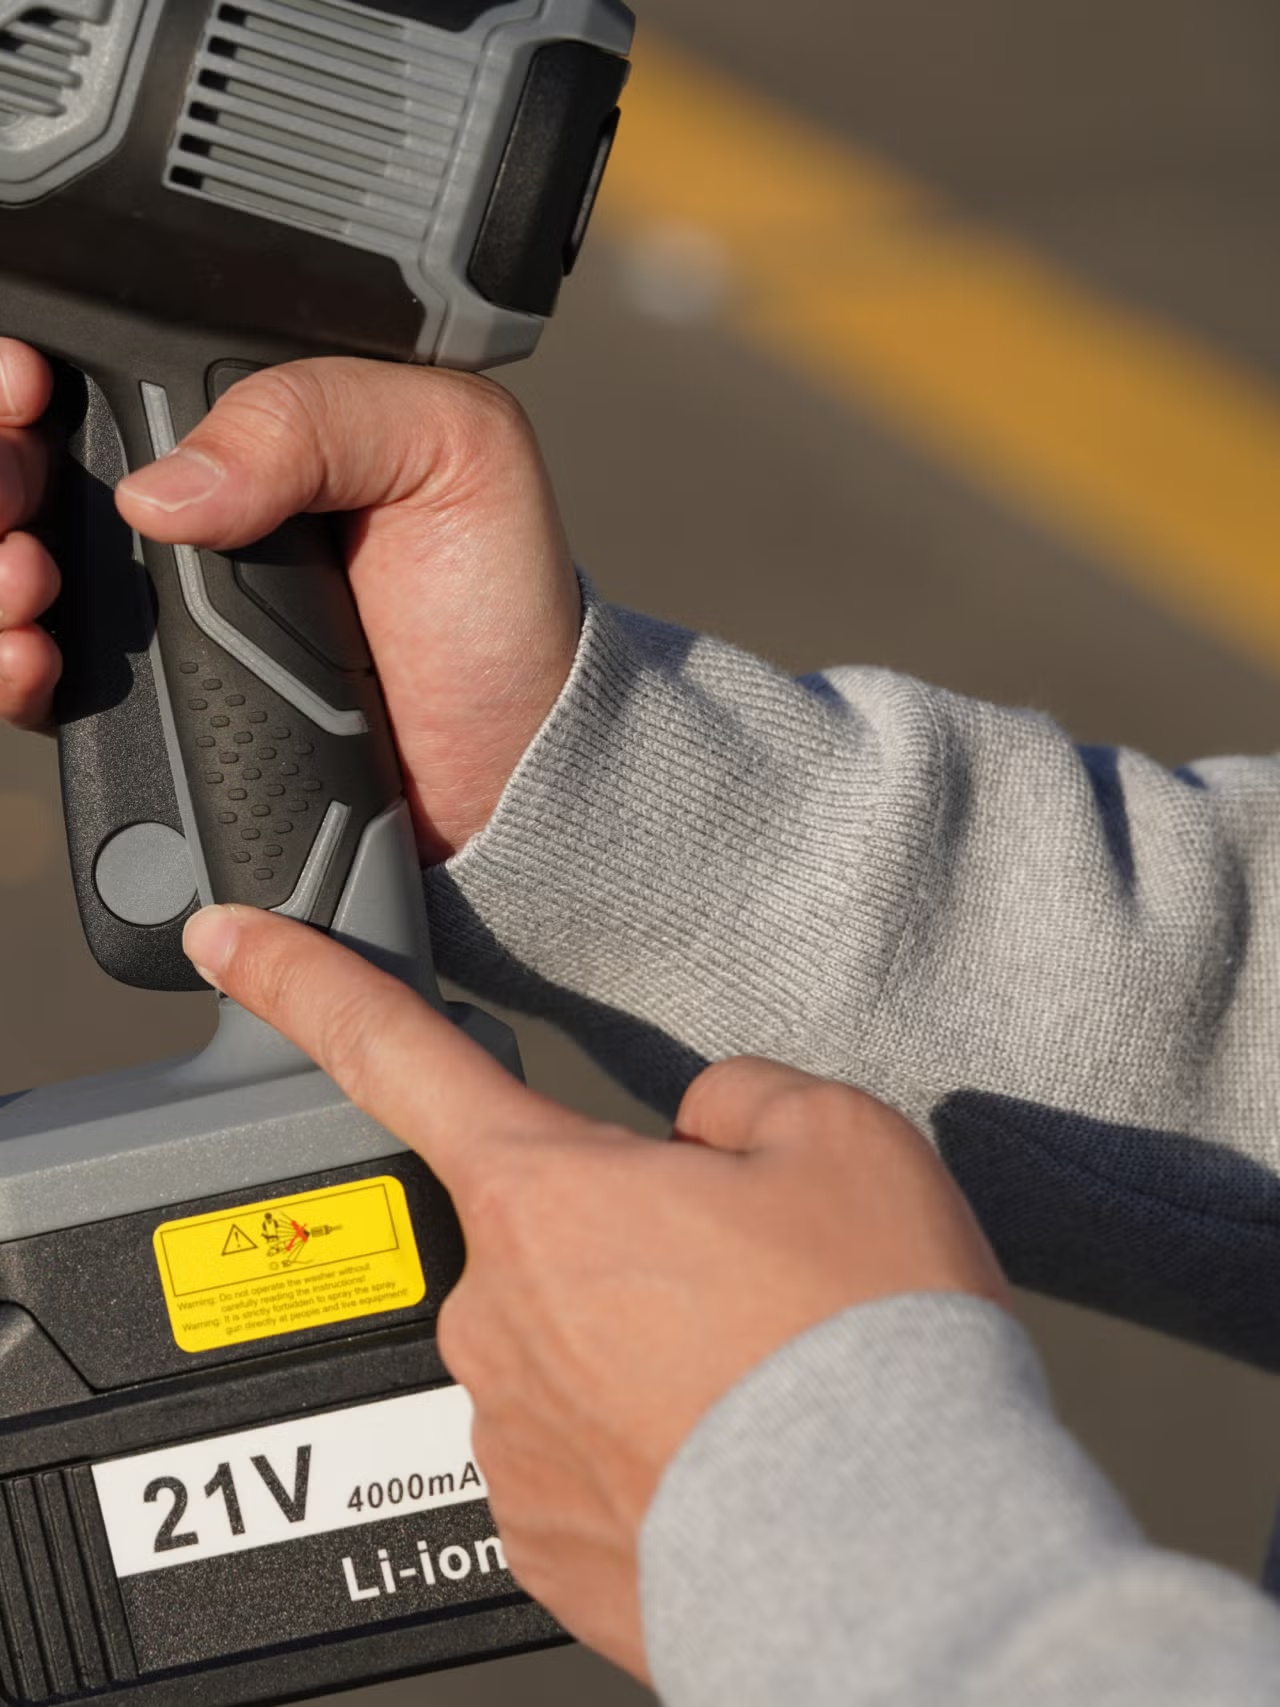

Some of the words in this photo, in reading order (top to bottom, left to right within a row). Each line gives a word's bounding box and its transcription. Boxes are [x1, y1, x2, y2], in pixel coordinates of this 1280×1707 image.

[177, 1296, 217, 1310] Warning:
[219, 1293, 232, 1302] Do
[235, 1289, 249, 1298] not
[251, 1282, 285, 1296] operate
[287, 1278, 301, 1287] the
[304, 1271, 335, 1284] washer
[338, 1263, 370, 1276] without
[182, 1317, 221, 1332] Warning:
[224, 1315, 230, 1323] It
[232, 1314, 240, 1322] is
[242, 1307, 271, 1320] strictly
[272, 1298, 314, 1313] forbidden
[316, 1295, 325, 1303] to
[328, 1290, 352, 1302] spray
[354, 1286, 369, 1294] the
[371, 1281, 396, 1292] spray
[221, 1298, 258, 1312] carefully
[260, 1291, 295, 1304] reading
[296, 1287, 310, 1297] the
[312, 1274, 366, 1292] instructions!
[226, 1324, 242, 1336] gun
[245, 1316, 277, 1330] directly
[279, 1314, 288, 1322] at
[290, 1306, 320, 1320] people
[323, 1302, 339, 1312] and
[341, 1299, 357, 1309] live
[359, 1287, 408, 1305] equipment!
[143, 1444, 312, 1553] 21V
[342, 1536, 508, 1602] Li-ion
